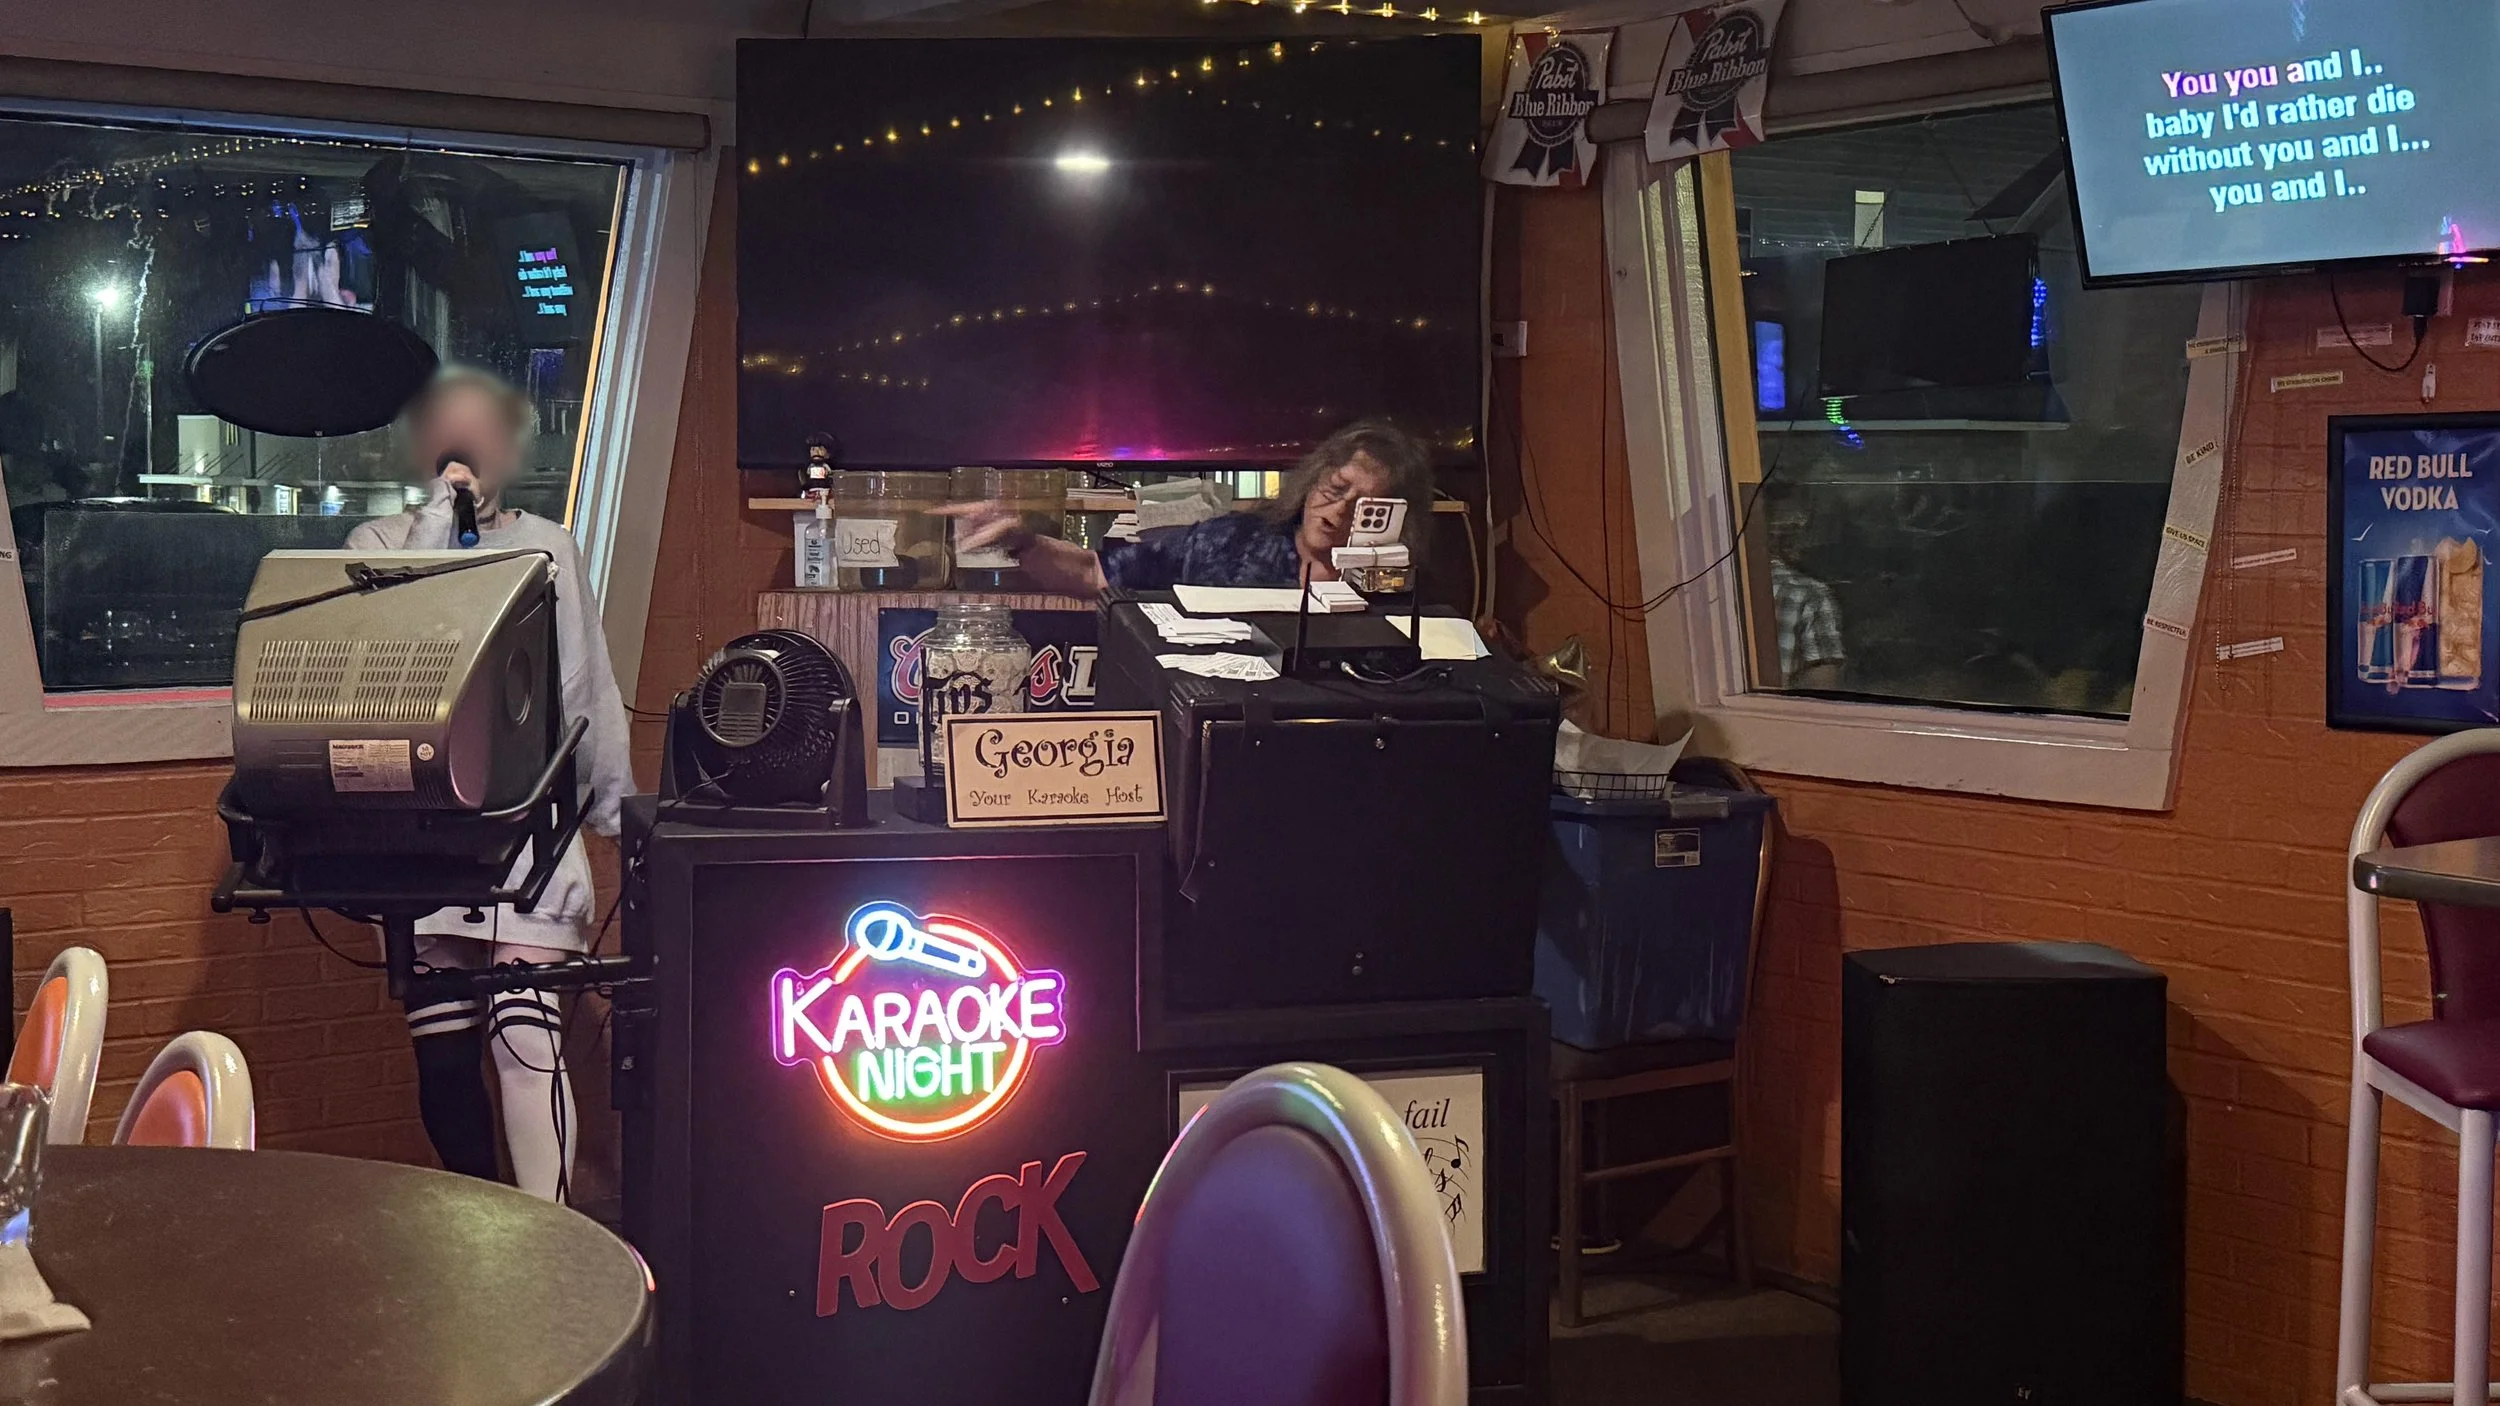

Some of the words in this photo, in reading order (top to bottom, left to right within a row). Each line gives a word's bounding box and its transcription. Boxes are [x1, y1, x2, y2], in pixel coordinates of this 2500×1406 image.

[1699, 27, 1754, 63] Pabst
[1535, 56, 1579, 89] Pabst
[1668, 69, 1709, 94] Blue
[1709, 56, 1767, 83] Ribbon
[2161, 70, 2218, 98] You
[2224, 65, 2279, 97] you
[2286, 50, 2343, 83] and
[1511, 92, 1545, 117] Blue
[2145, 108, 2215, 139] baby
[2222, 100, 2260, 130] I'd
[2266, 93, 2358, 126] rather
[2367, 83, 2416, 114] die
[2143, 141, 2254, 176] without
[2258, 139, 2315, 171] you
[2321, 126, 2379, 158] and
[2208, 182, 2264, 213] you
[2270, 170, 2327, 201] and
[2369, 455, 2413, 479] RED
[2416, 453, 2473, 479] BULL
[2381, 485, 2459, 511] VODKA
[842, 530, 881, 555] Used
[975, 728, 1135, 778] Georgia
[969, 789, 1012, 807] Your
[1027, 786, 1090, 805] Karaoke
[1105, 783, 1143, 806] Host
[779, 976, 1060, 1060] KARAOKE
[857, 1042, 1007, 1103] NIGHT
[1404, 1098, 1451, 1130] fail
[816, 1151, 1100, 1317] ROCK
